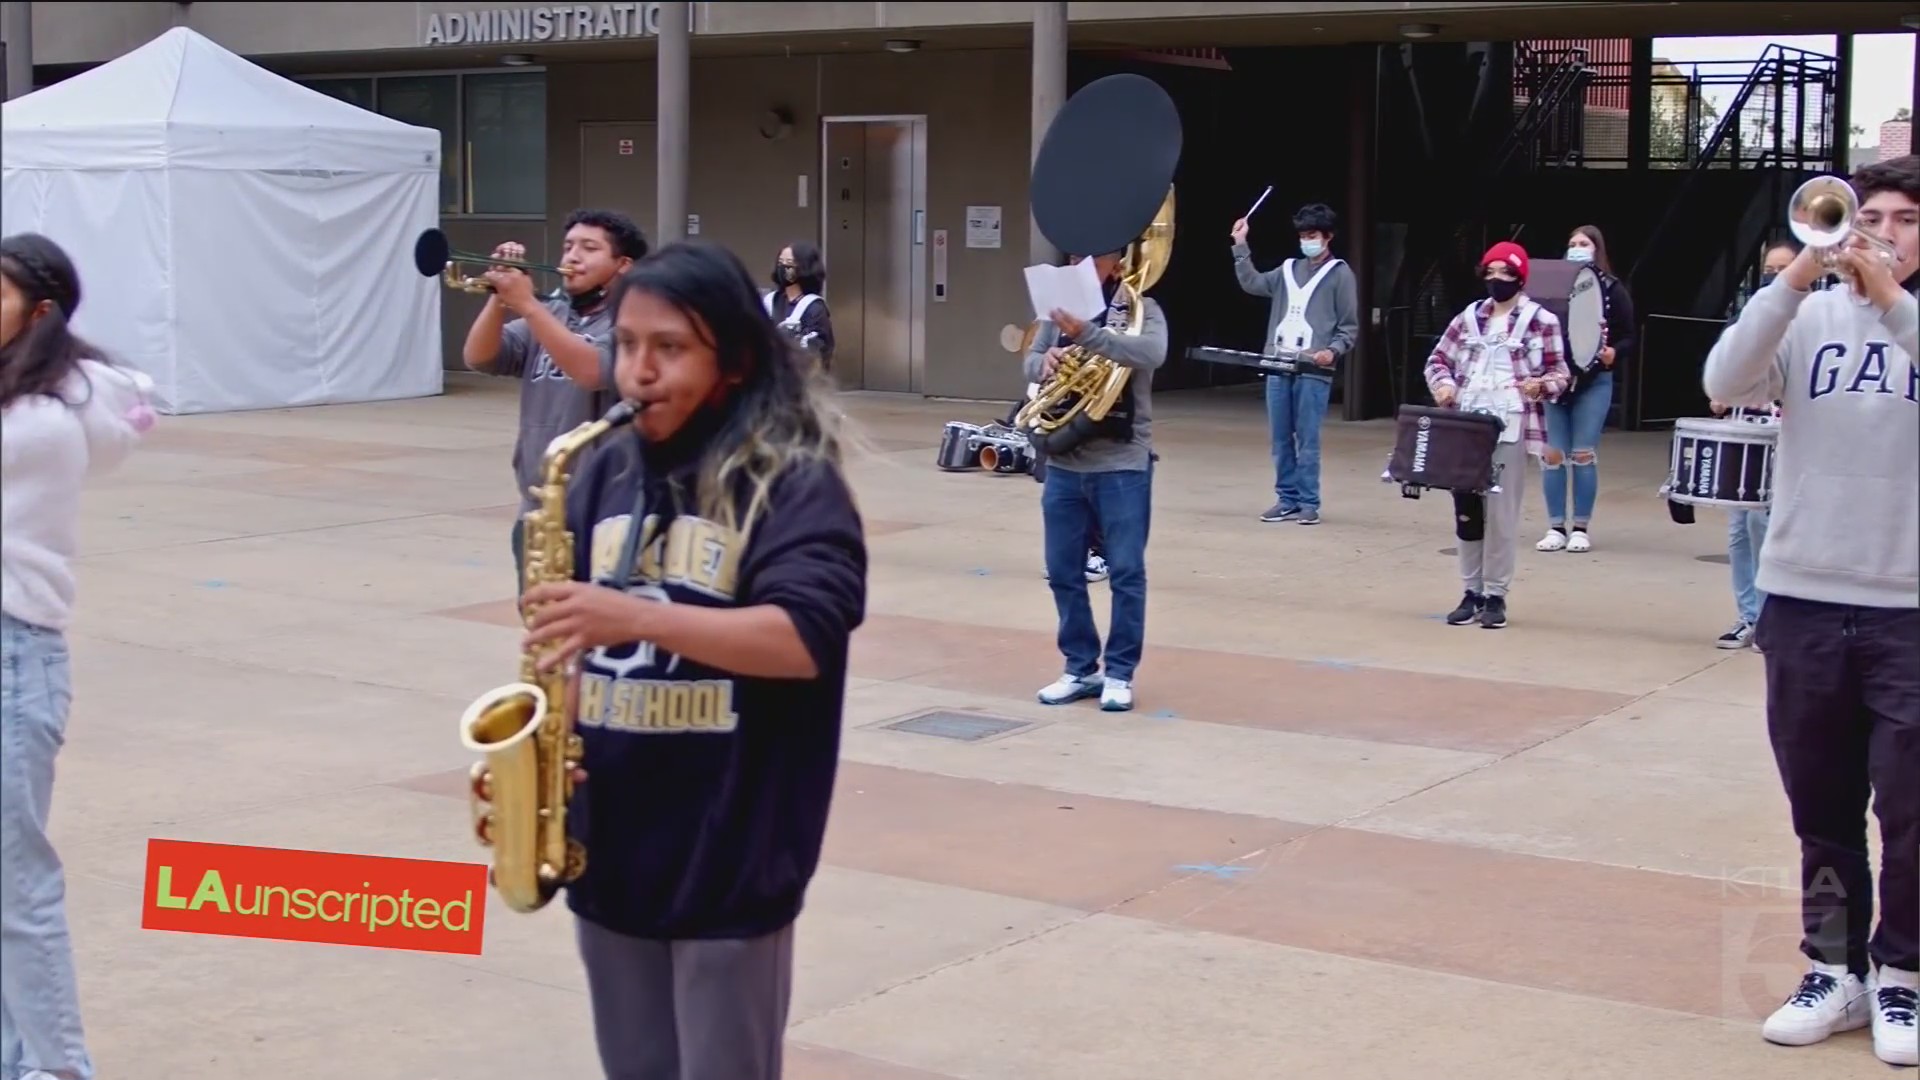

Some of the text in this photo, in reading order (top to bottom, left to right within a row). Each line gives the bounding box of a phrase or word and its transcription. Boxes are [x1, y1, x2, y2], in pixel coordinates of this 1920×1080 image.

[425, 4, 694, 45] ADMINISTRATIO
[1412, 430, 1430, 472] YAMAHA
[1699, 458, 1712, 495] YAMAHA
[606, 678, 739, 733] SCHOOL
